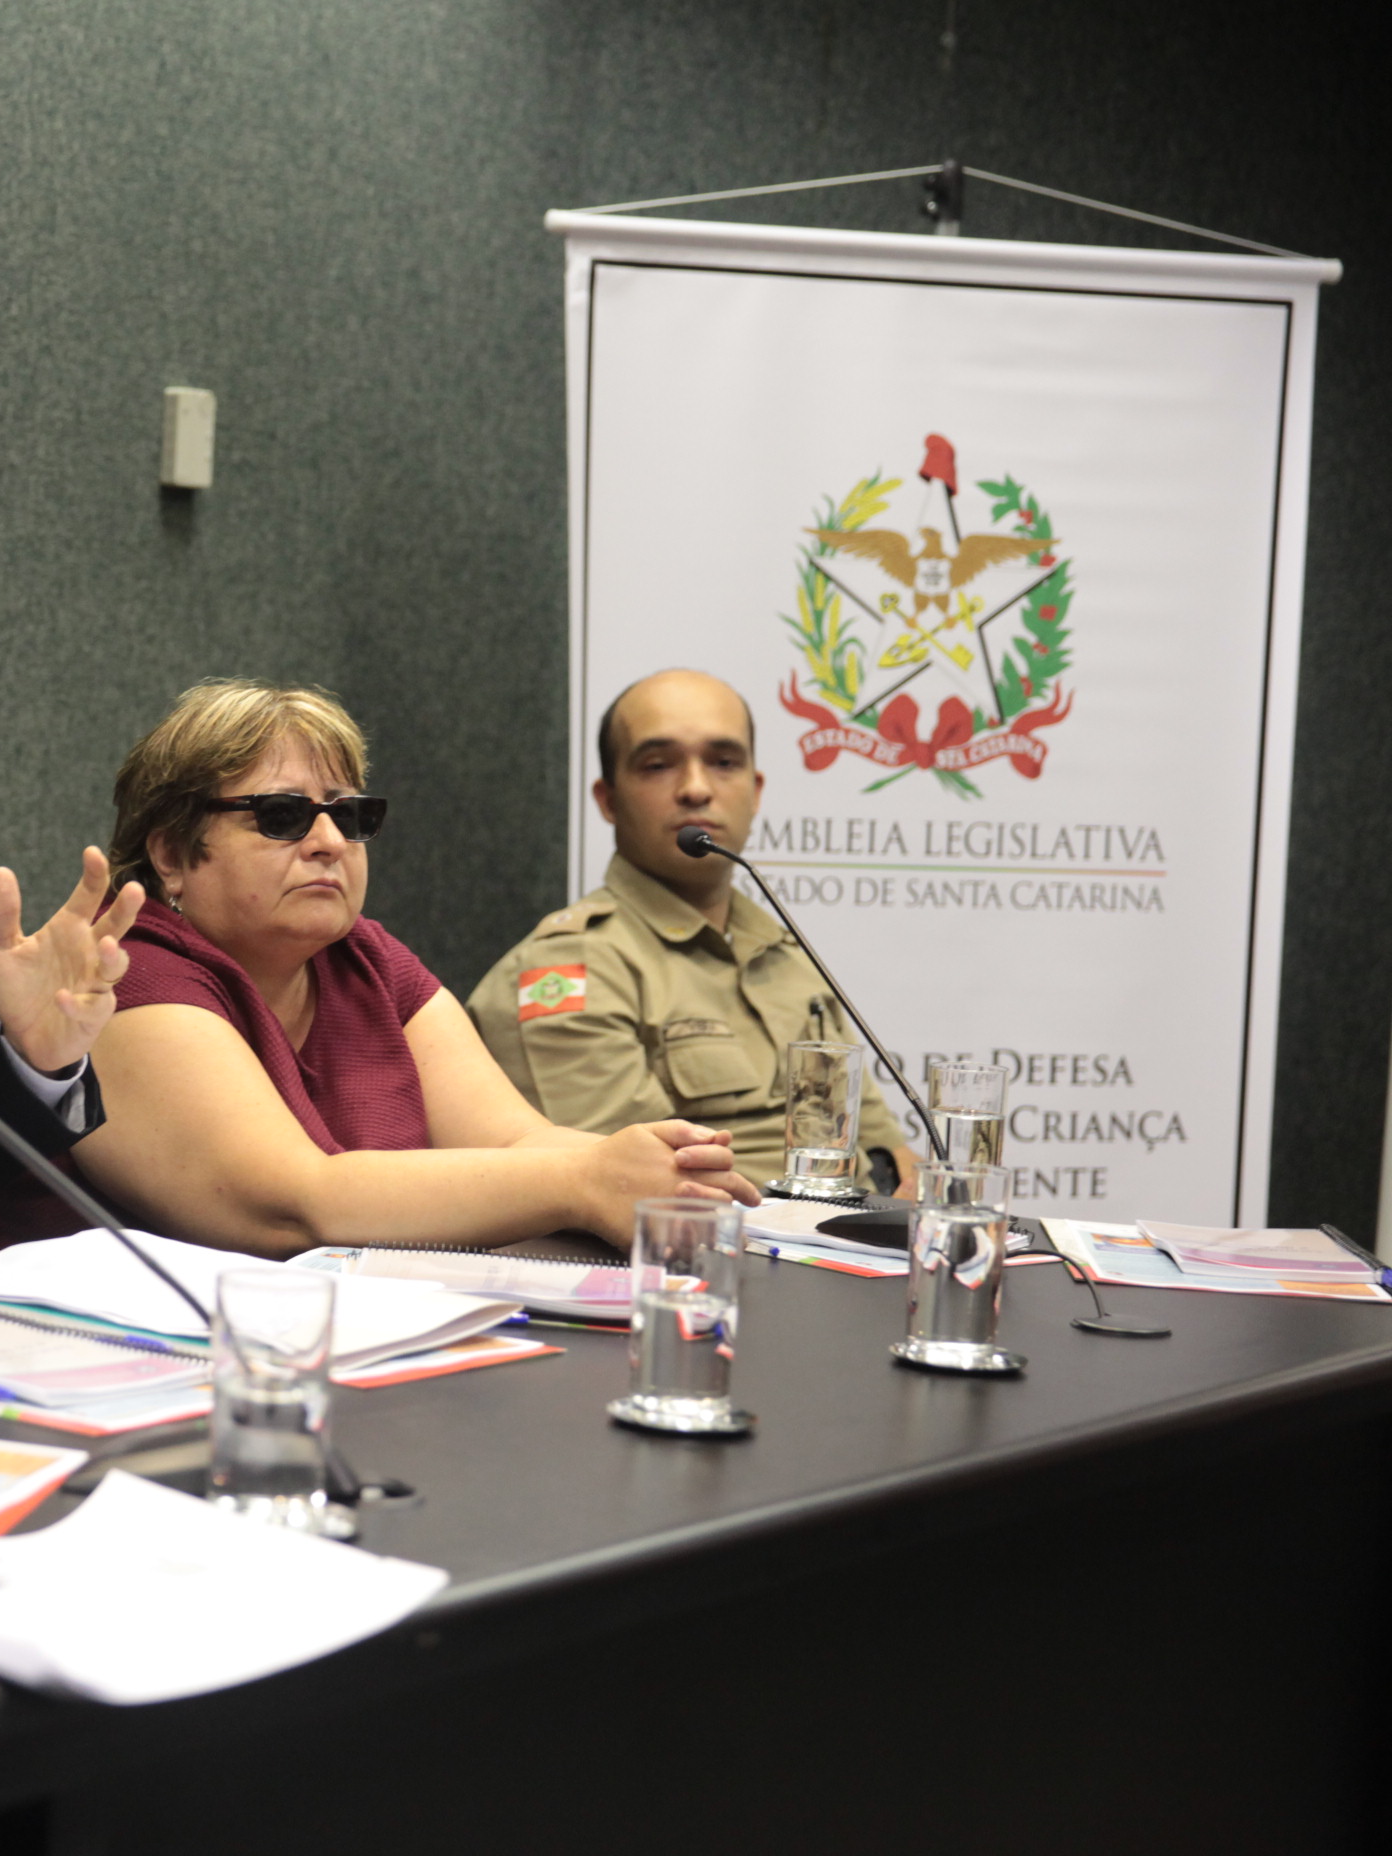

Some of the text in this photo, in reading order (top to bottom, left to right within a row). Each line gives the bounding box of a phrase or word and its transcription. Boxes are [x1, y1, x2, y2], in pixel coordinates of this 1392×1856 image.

[804, 728, 875, 755] ESTADO
[872, 742, 899, 765] DE
[747, 816, 1167, 863] MBLEIA LEGISLATIVA
[854, 875, 897, 909] DE
[905, 877, 1003, 912] SANTA
[1009, 879, 1167, 914] CATARINA
